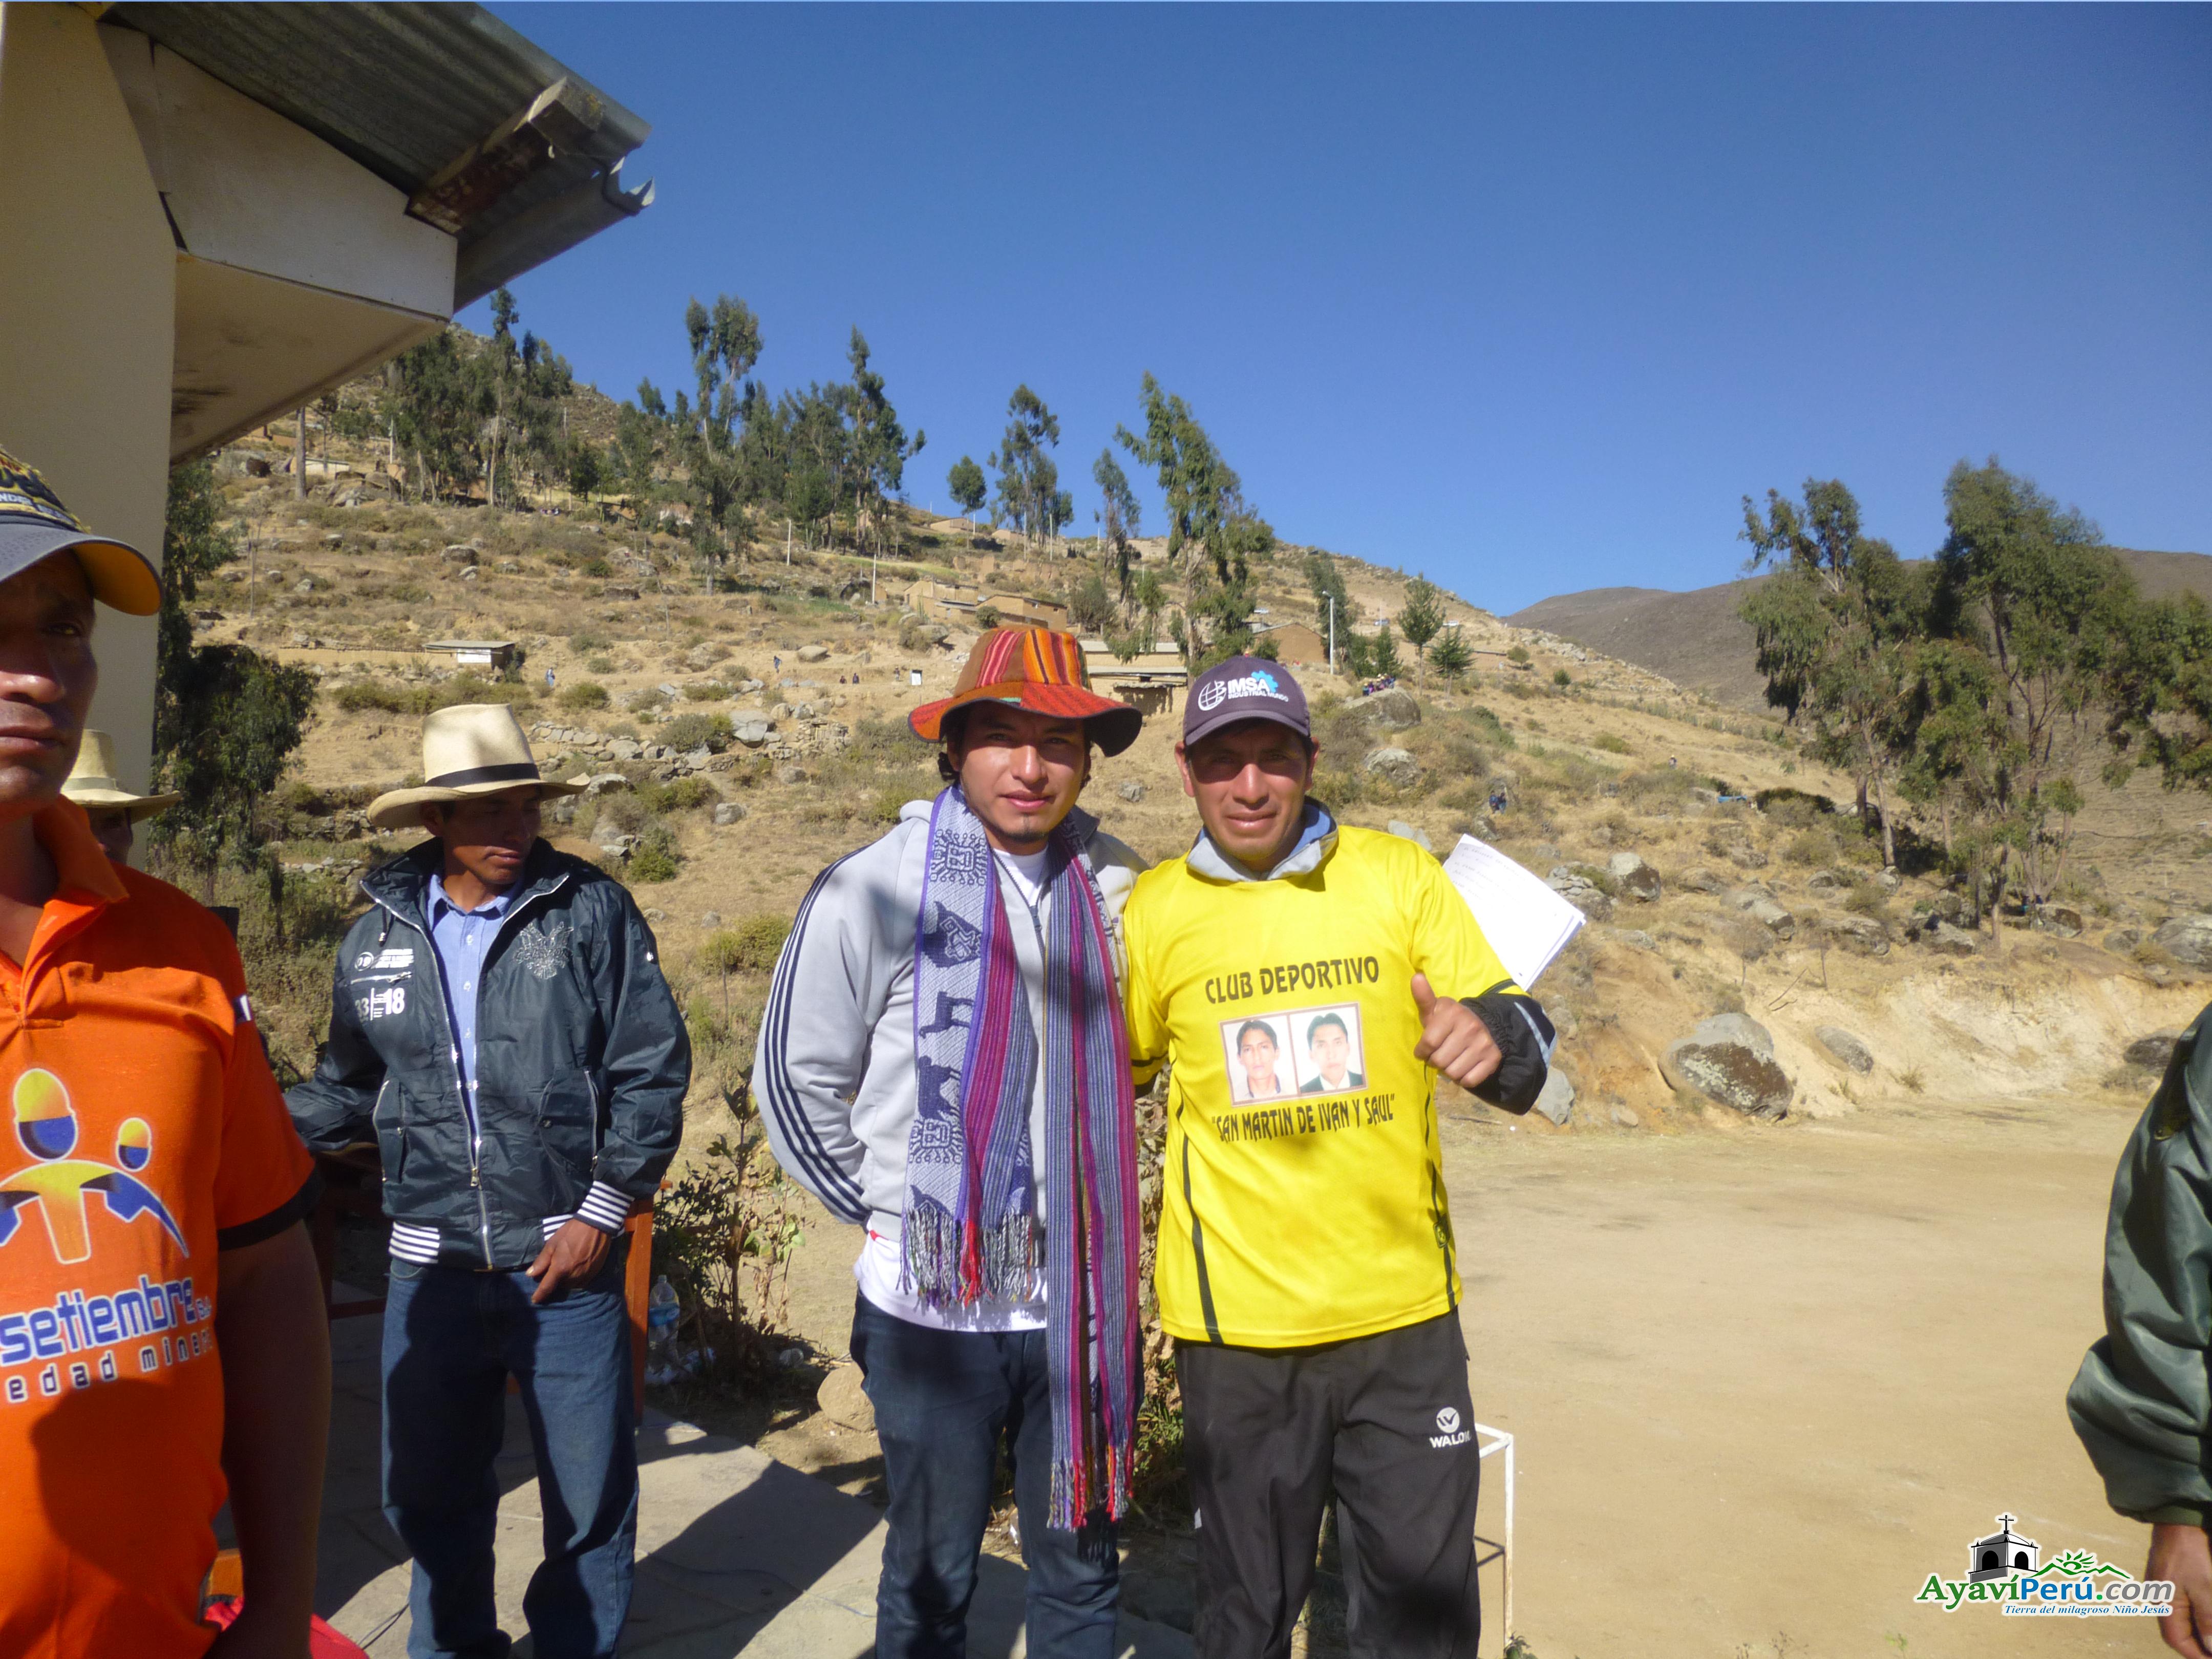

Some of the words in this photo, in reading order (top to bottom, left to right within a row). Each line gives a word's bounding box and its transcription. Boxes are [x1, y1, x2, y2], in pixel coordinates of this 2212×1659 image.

[1227, 677, 1270, 693] IMSA
[1228, 689, 1266, 699] INDUSTRIAL
[1267, 691, 1289, 703] MUNDO
[1205, 971, 1253, 1005] CLUB
[1259, 955, 1379, 995] DEPORTIVO
[1242, 1107, 1294, 1142] MARTIN
[1296, 1105, 1316, 1134] DE
[1317, 1100, 1350, 1132] IVAN
[1352, 1099, 1360, 1129] Y
[0, 1274, 197, 1366] setiembre
